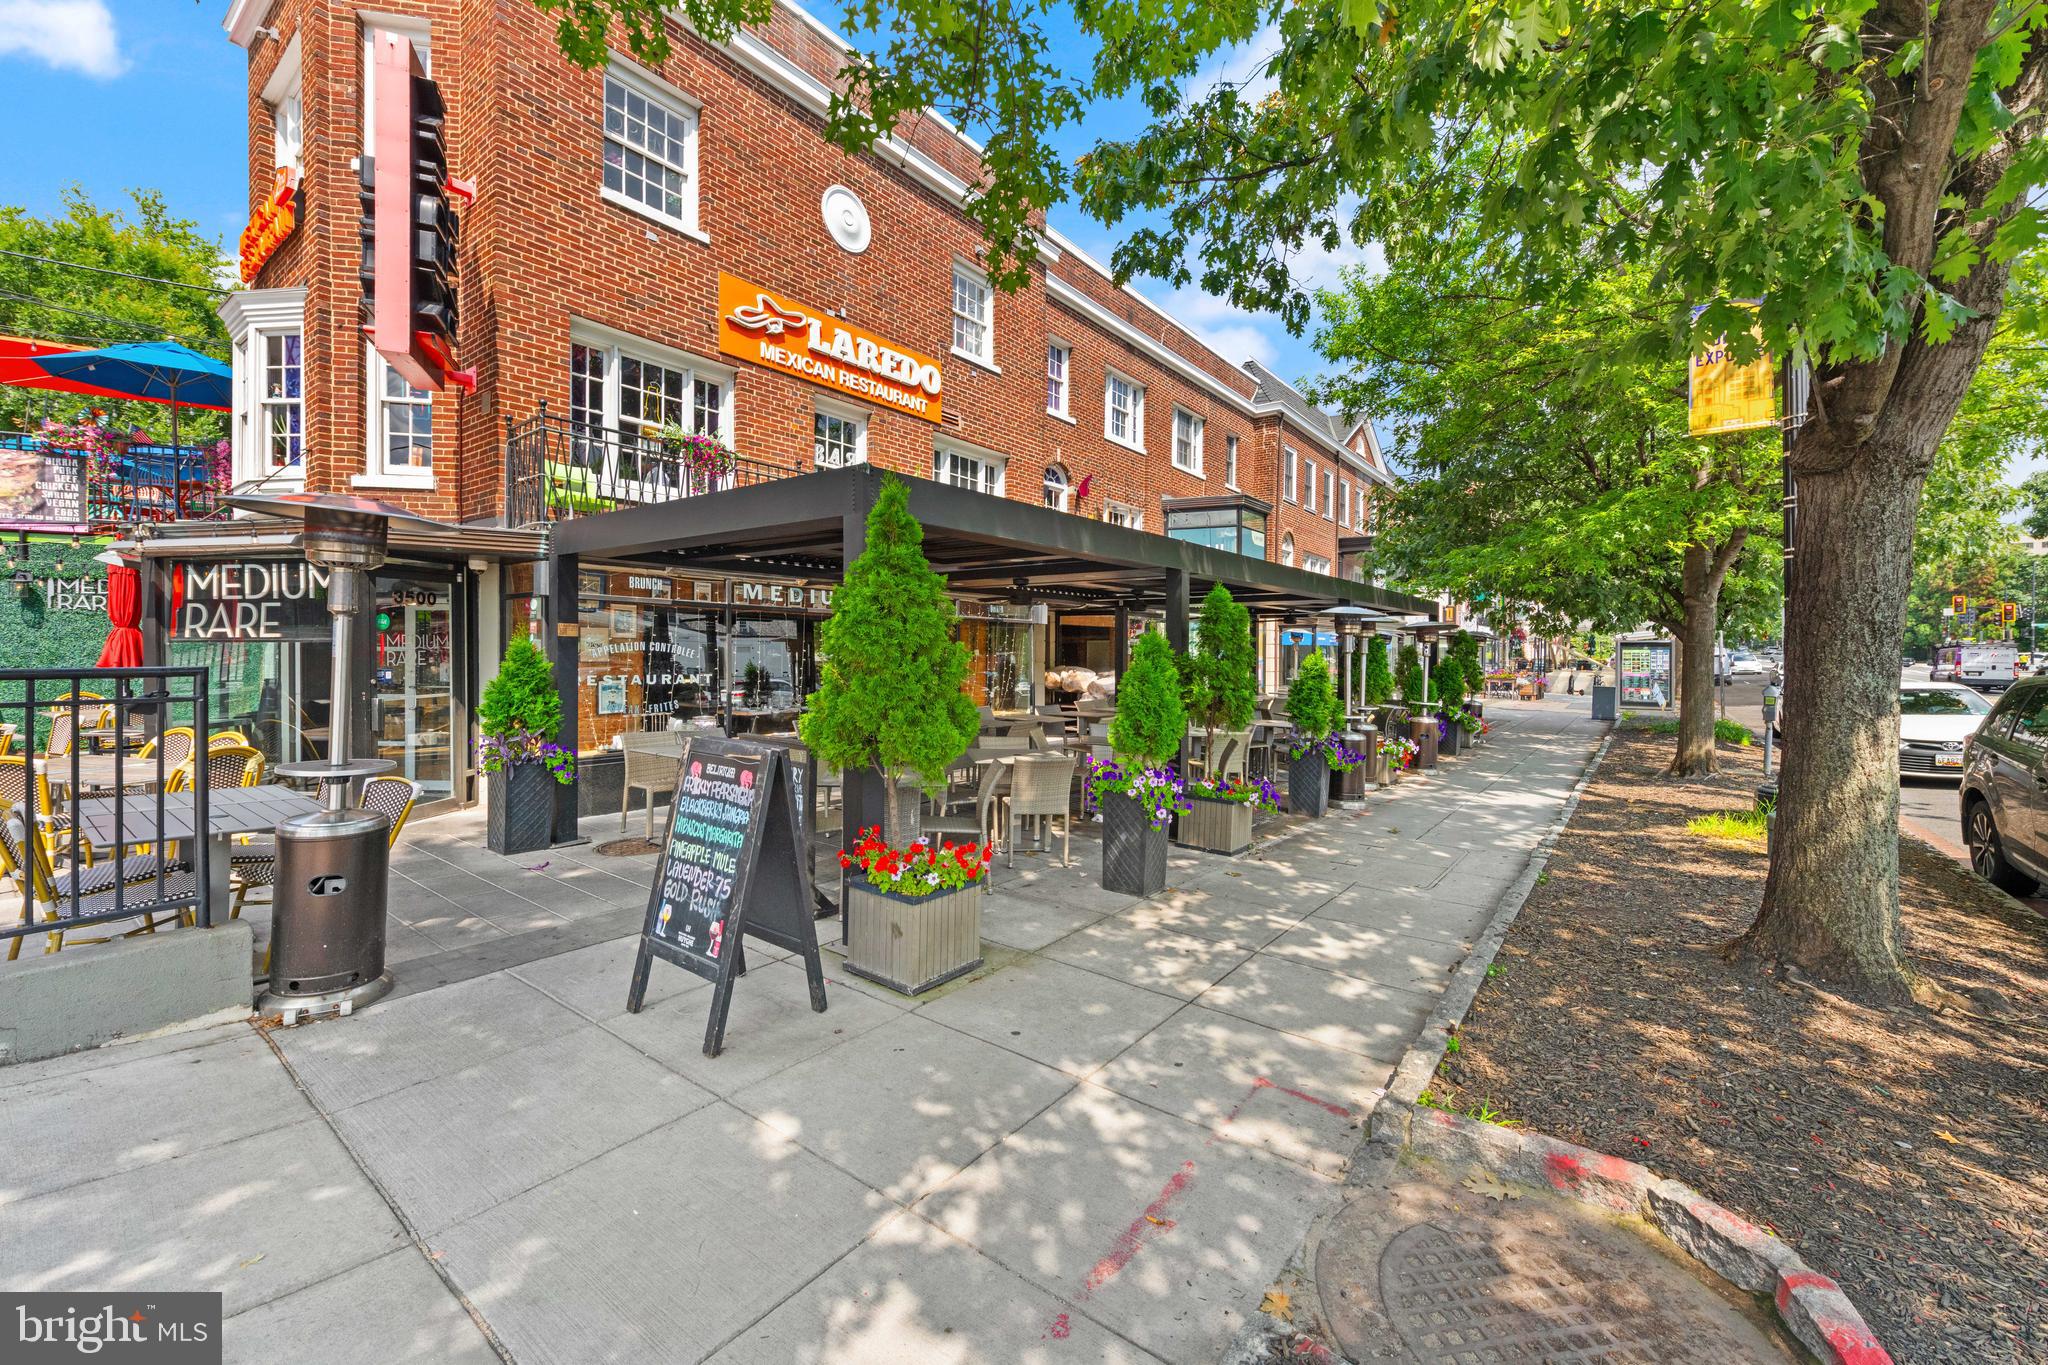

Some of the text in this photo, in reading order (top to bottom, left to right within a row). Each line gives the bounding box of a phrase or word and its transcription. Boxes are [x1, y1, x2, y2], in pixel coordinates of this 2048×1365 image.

[807, 317, 942, 395] LAREDO
[760, 341, 928, 415] MEXICAN RESTAURANT
[53, 466, 78, 475] PORK
[54, 474, 78, 483] BEEF
[35, 481, 79, 491] CHICKEN
[41, 490, 79, 500] SHRIMP
[46, 499, 79, 508] VEGAN
[54, 508, 79, 517] EGGS
[57, 578, 108, 595] MED
[186, 563, 330, 600] MEDIUM
[629, 576, 663, 591] BRUNCH
[57, 593, 108, 611] RAR
[392, 590, 437, 606] 3500
[743, 583, 833, 605] MEDIU
[184, 602, 282, 638] RARE
[578, 673, 713, 687] ESTAURANT
[649, 700, 680, 714] FRITES
[680, 796, 722, 819] BLACKBERRY
[705, 825, 745, 849] MARGARITA
[669, 837, 737, 874] PINEAPPLE MULE
[715, 875, 731, 899] 75
[664, 878, 721, 921] GOLD RUSH
